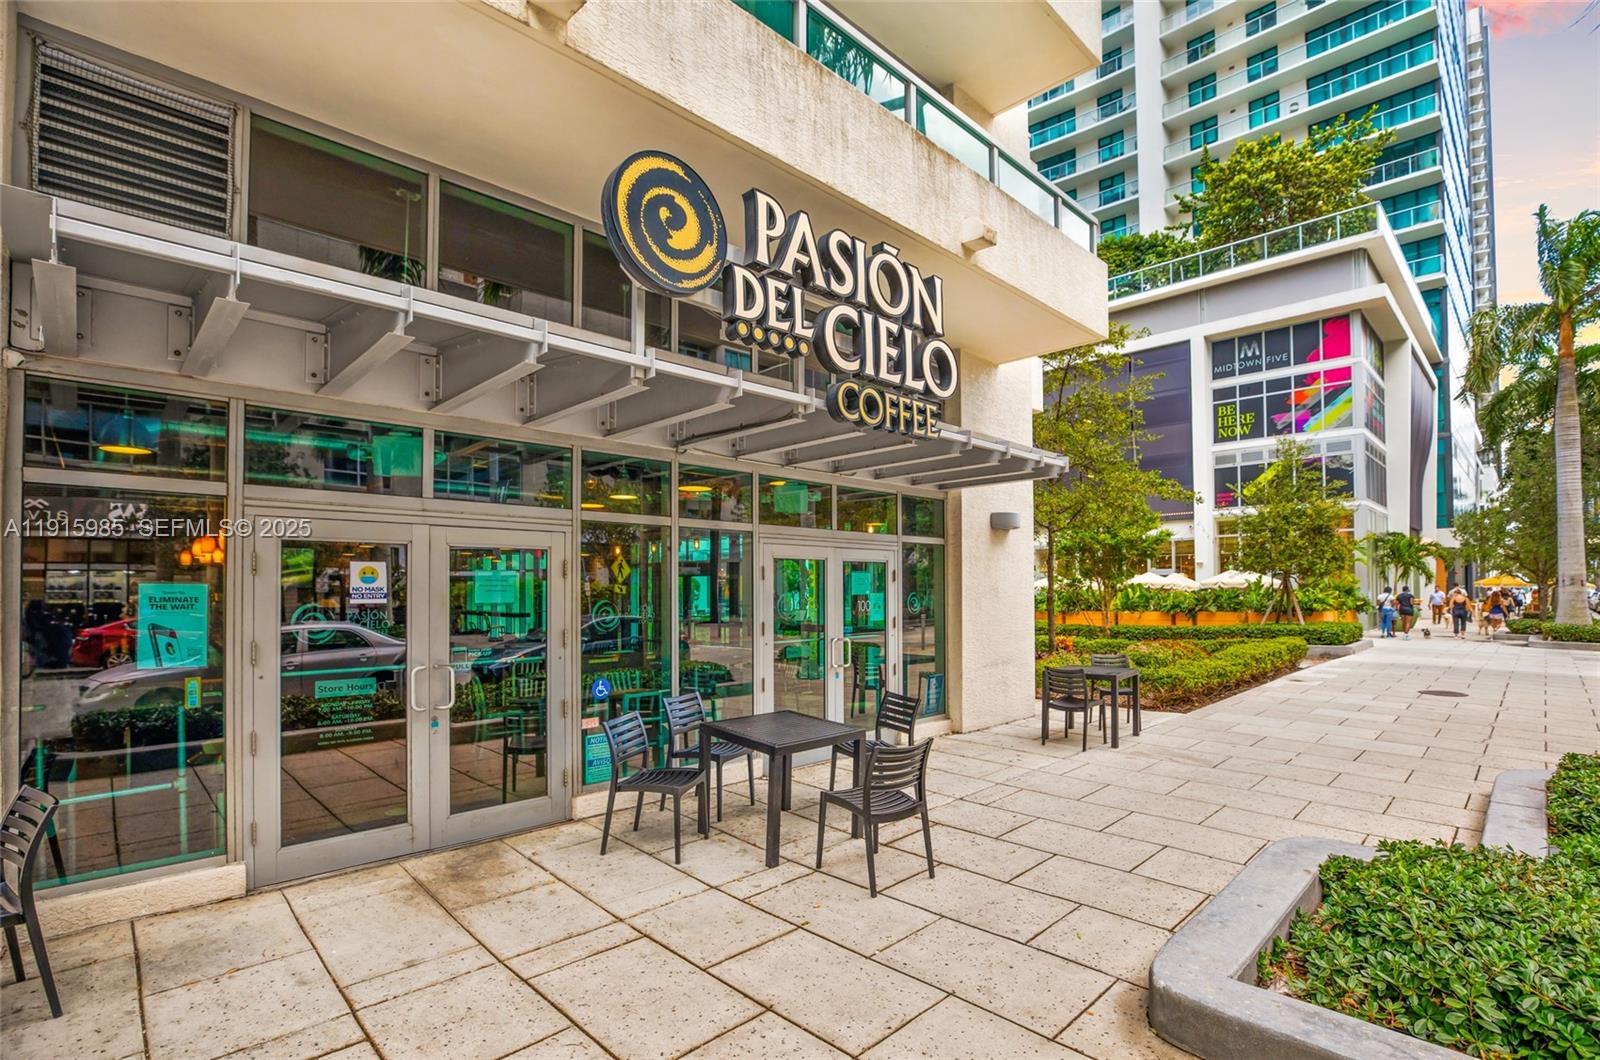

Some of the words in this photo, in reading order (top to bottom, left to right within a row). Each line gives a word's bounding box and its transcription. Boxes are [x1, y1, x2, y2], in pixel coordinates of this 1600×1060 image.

[725, 264, 815, 338] DEL
[814, 304, 959, 398] CIELO
[1266, 353, 1288, 364] FIVE
[828, 381, 942, 439] COFFEE
[1218, 404, 1236, 417] BE
[1218, 412, 1255, 427] HERE
[1218, 424, 1252, 438] NOW
[148, 596, 200, 604] ELIMINATE
[857, 600, 872, 612] 100
[150, 603, 168, 611] THE
[318, 685, 344, 693] Store
[347, 683, 374, 691] Hours
